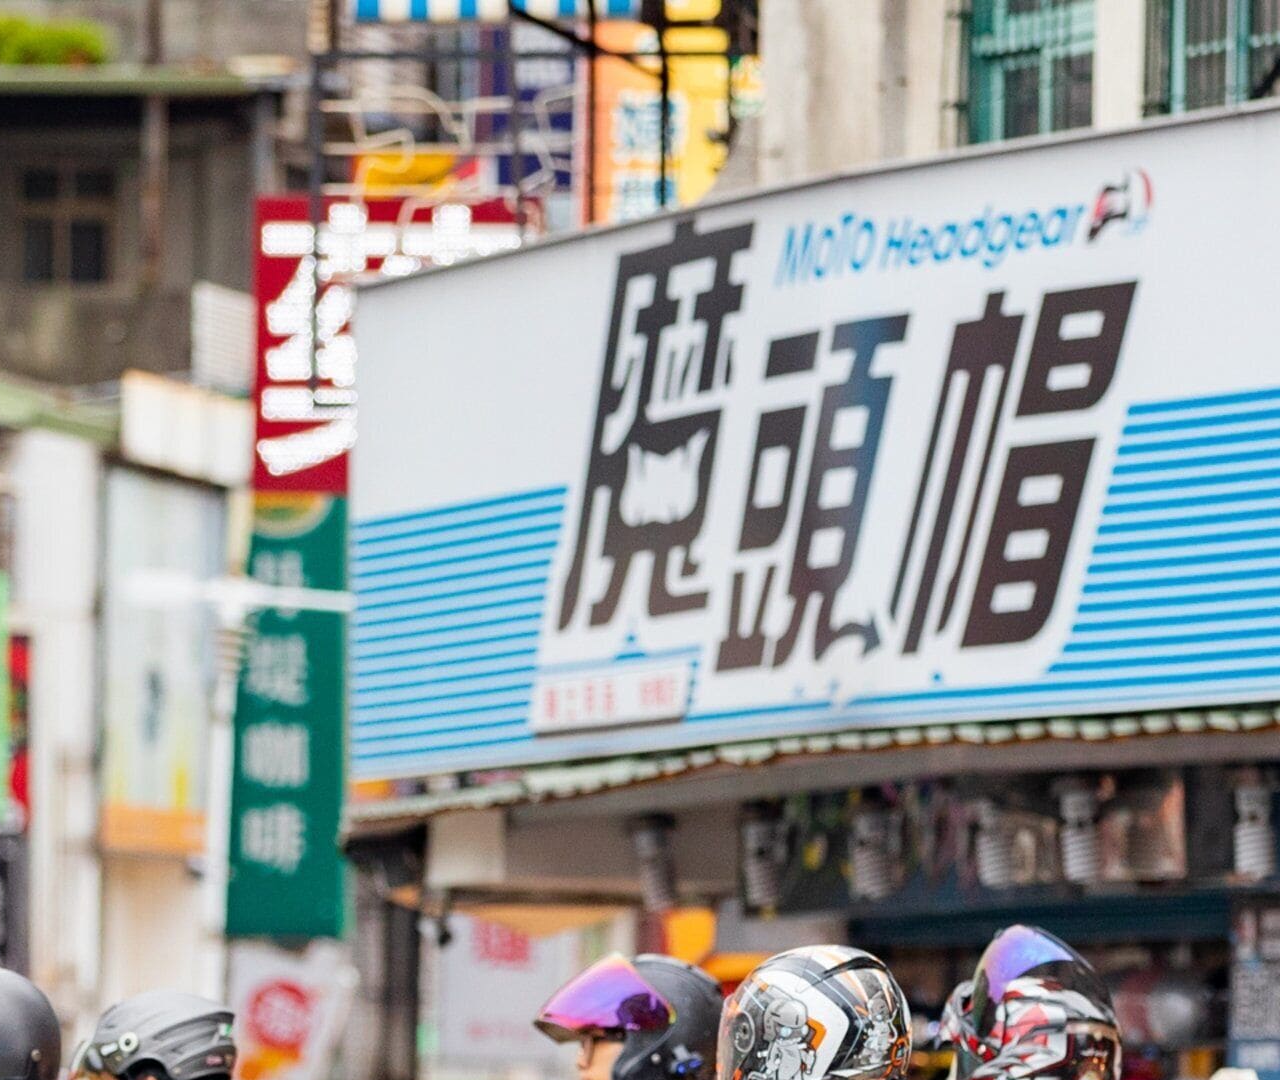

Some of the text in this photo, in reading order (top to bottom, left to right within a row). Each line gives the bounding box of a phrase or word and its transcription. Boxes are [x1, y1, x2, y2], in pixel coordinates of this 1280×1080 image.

[881, 203, 1084, 268] Headgear
[559, 220, 1140, 673] 魔頭帽
